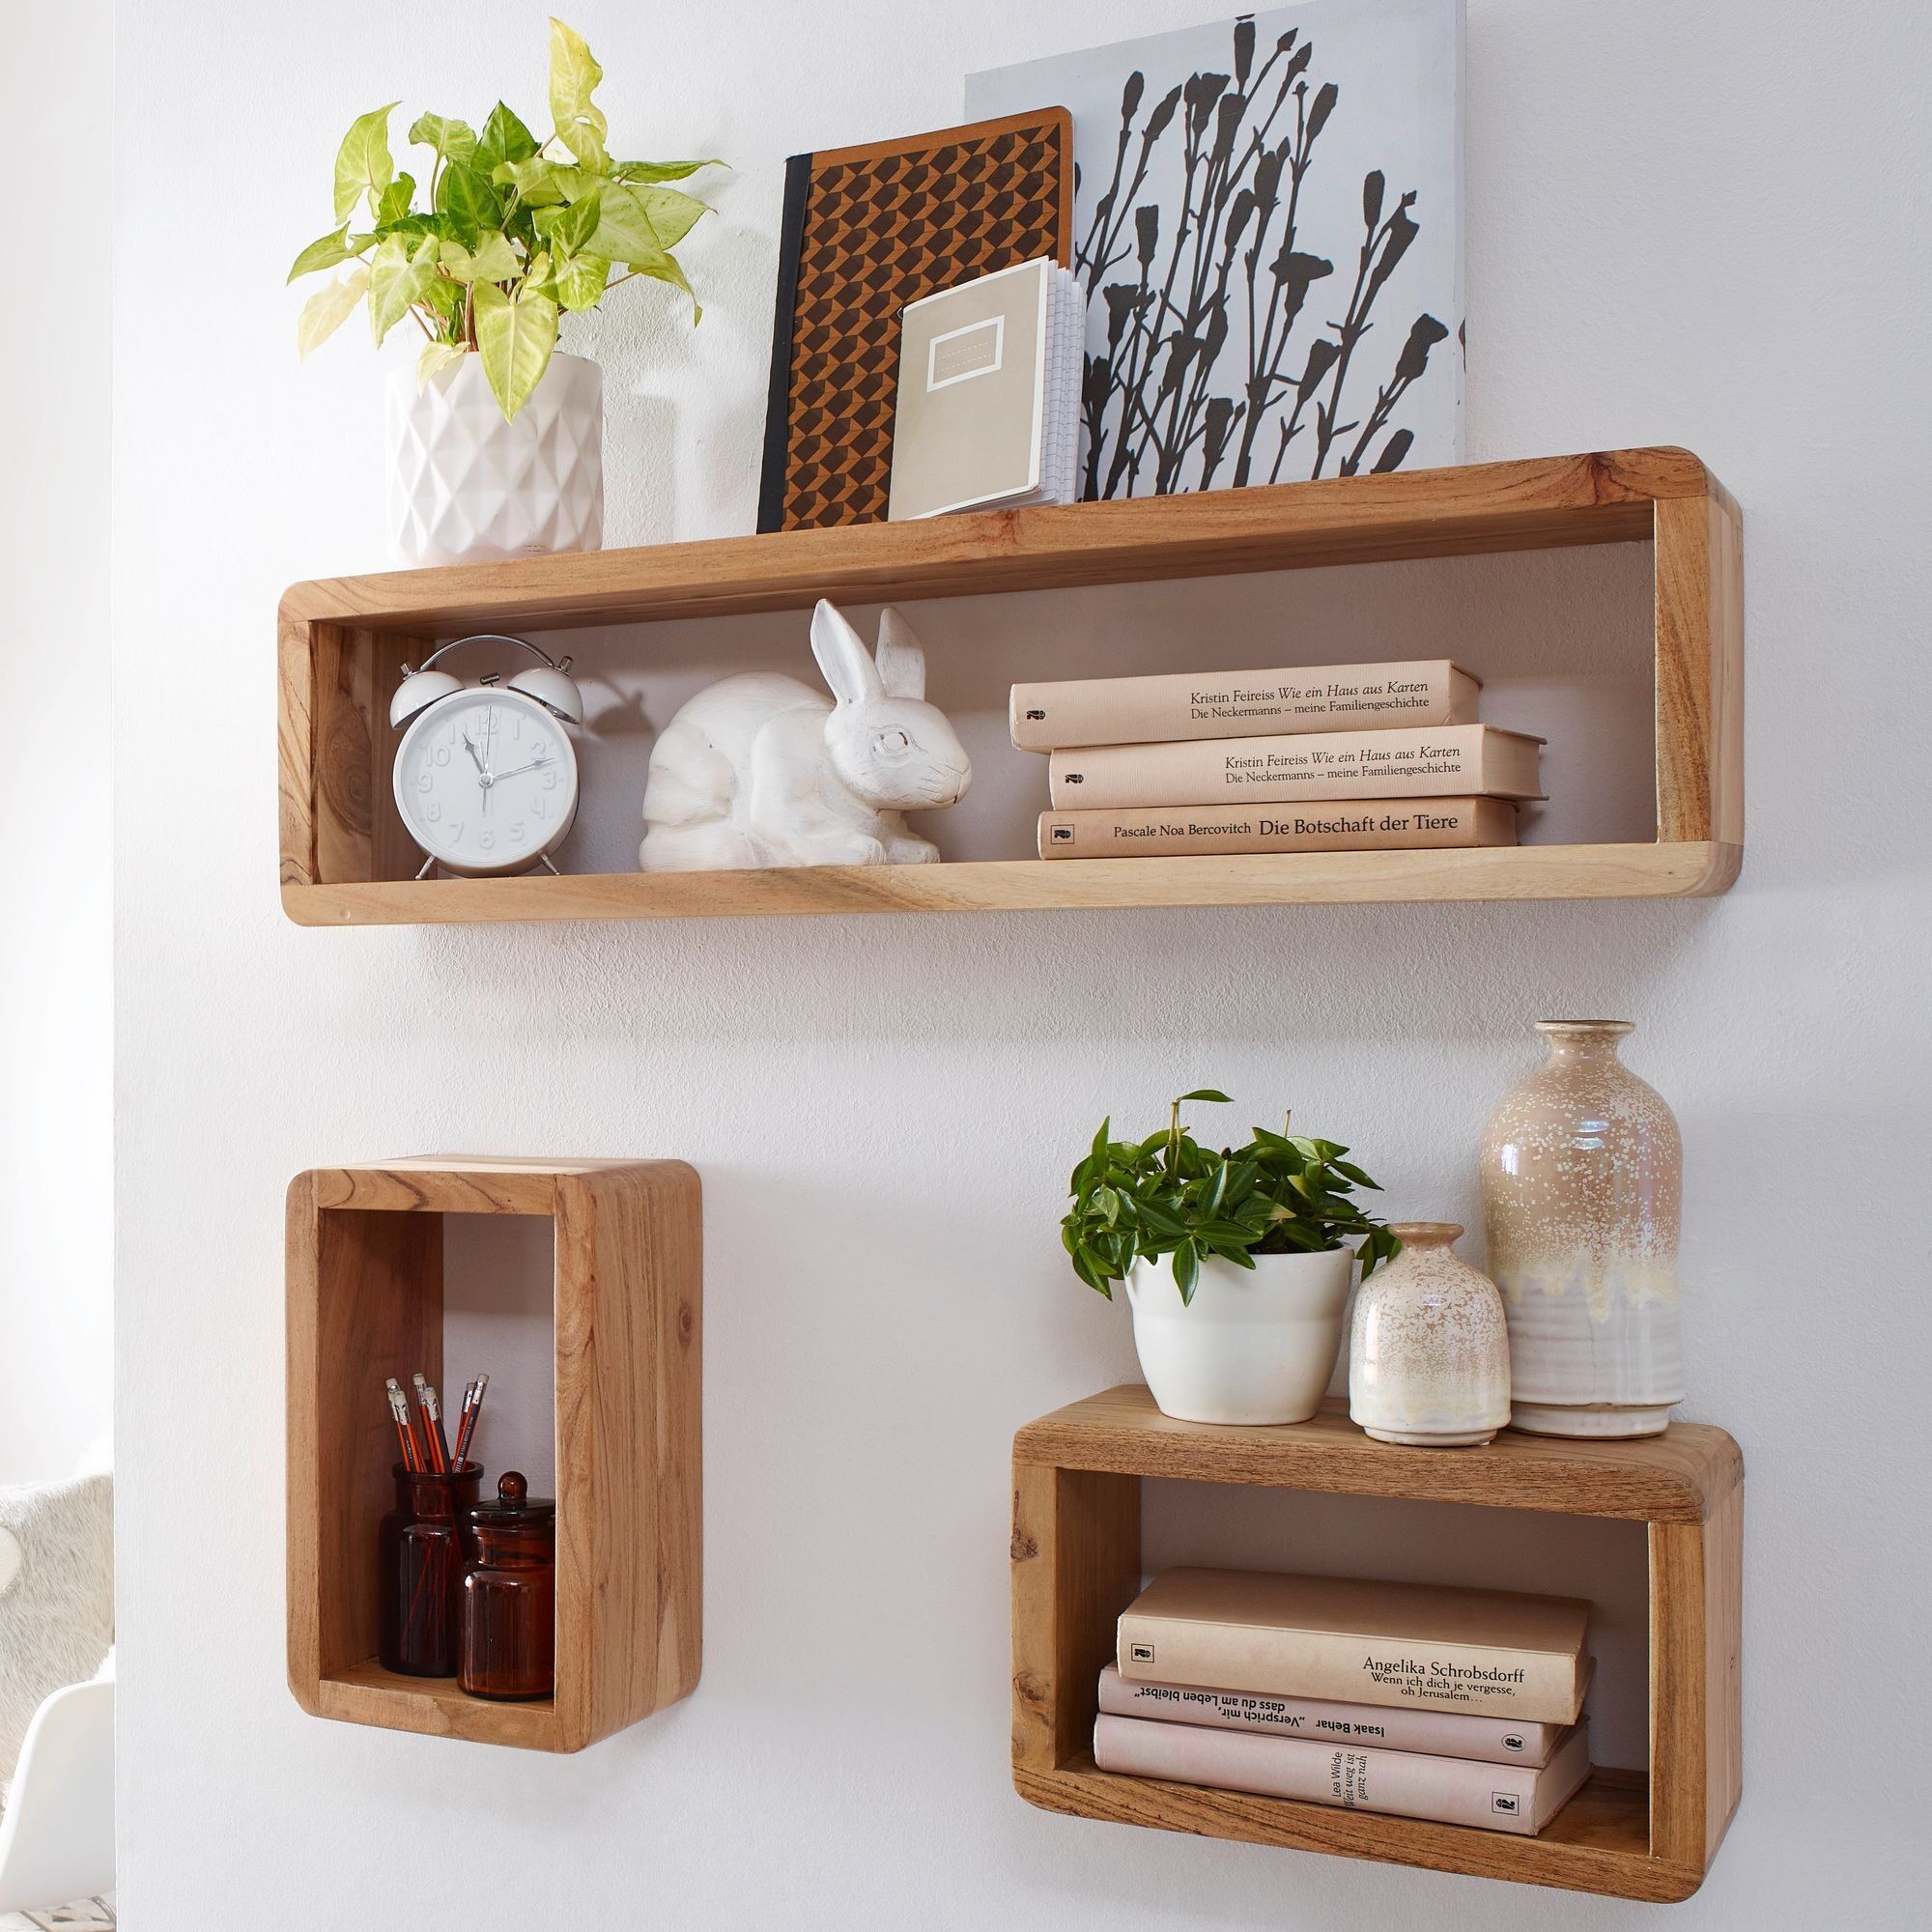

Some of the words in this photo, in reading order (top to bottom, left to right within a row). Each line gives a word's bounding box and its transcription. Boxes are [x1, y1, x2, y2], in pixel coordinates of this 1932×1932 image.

[1191, 692, 1230, 704] Kristin
[1233, 690, 1275, 702] Feireiss
[1278, 687, 1301, 699] Wie
[1305, 686, 1322, 697] ein
[1326, 684, 1358, 696] Haus
[1362, 685, 1382, 696] aus
[1387, 681, 1429, 694] Karten
[1191, 708, 1208, 719] Die
[1211, 705, 1282, 718] Neckermanns
[1294, 703, 1326, 713] meine
[1329, 696, 1430, 712] Familiengeschichte
[426, 745, 451, 767] 10
[1226, 756, 1264, 769] Kristin
[1266, 754, 1308, 767] Feireiss
[1312, 752, 1334, 764] Wie
[1338, 751, 1355, 762] ein
[1359, 749, 1391, 761] Haus
[1395, 751, 1415, 759] aus
[1419, 746, 1461, 758] Karten
[542, 770, 557, 790] 3
[1226, 773, 1243, 783] Die
[1246, 771, 1315, 782] Neckermanns
[1327, 768, 1358, 778] meine
[1362, 761, 1462, 777] Familiengeschichte
[417, 773, 433, 793] 9
[427, 801, 441, 822] 8
[449, 821, 465, 843] 7
[510, 819, 525, 841] 5
[1114, 825, 1156, 838] Pascale
[1159, 825, 1184, 836] Noa
[1188, 822, 1252, 835] Bercovitch
[1259, 820, 1290, 835] Die
[1294, 815, 1375, 835] Botschaft
[1379, 815, 1409, 831] der
[1413, 814, 1459, 830] Tiere
[479, 827, 495, 849] 6
[1363, 1656, 1425, 1675] Angelika
[1431, 1661, 1525, 1684] Schrobsdorff
[1371, 1672, 1403, 1685] Wenn
[1406, 1676, 1423, 1687] ich
[1427, 1678, 1450, 1690] dich
[1453, 1681, 1463, 1691] je
[1466, 1685, 1516, 1697] vergesse,
[1401, 1686, 1415, 1696] oh
[1182, 1692, 1219, 1706] Leben
[1222, 1696, 1239, 1707] am
[1241, 1698, 1257, 1711] du
[1259, 1700, 1286, 1713] dass
[1218, 1706, 1241, 1719] mir,
[1316, 1719, 1350, 1733] Behar
[1353, 1723, 1384, 1737] Isaak
[1331, 1751, 1343, 1778] Wilde
[1344, 1753, 1355, 1765] ist
[1355, 1755, 1367, 1775] nah
[1346, 1767, 1355, 1787] weg
[1332, 1781, 1342, 1798] Lea
[1344, 1789, 1355, 1806] Weit
[1358, 1777, 1369, 1801] ganz
